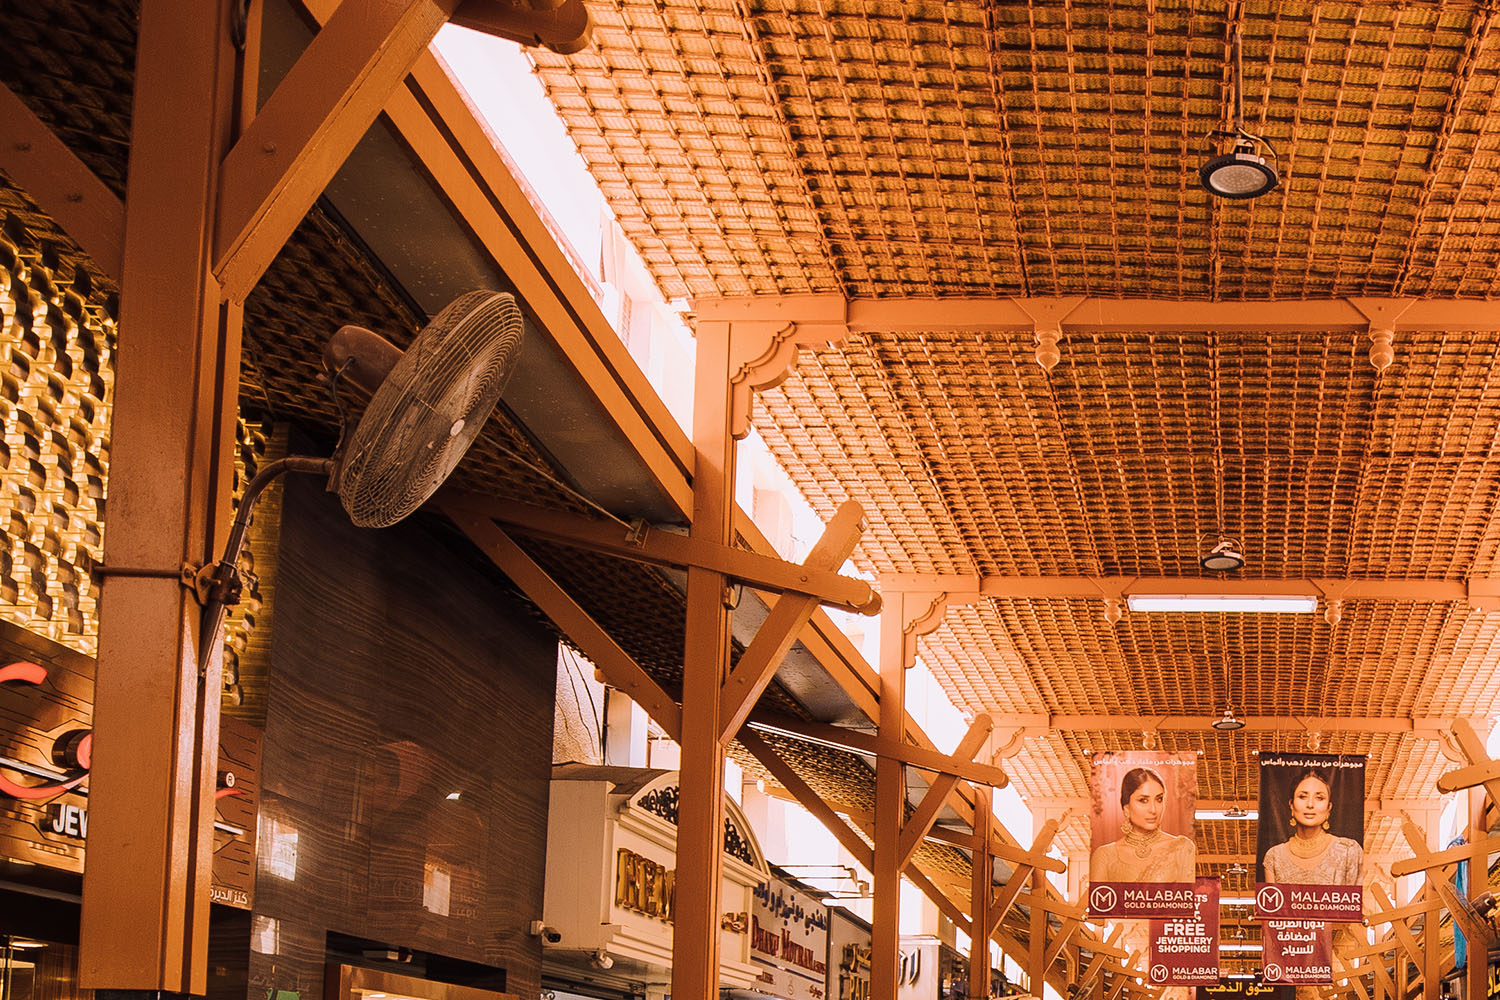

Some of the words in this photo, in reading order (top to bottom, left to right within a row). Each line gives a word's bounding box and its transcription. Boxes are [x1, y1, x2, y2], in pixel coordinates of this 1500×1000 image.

[1123, 890, 1194, 901] MALABAR
[1291, 891, 1361, 904] MALABAR
[1163, 923, 1205, 936] FREE
[1156, 937, 1213, 945] JEWELLERY
[1277, 931, 1316, 942] المضافة
[1158, 945, 1211, 954] SHOPPING!
[1281, 944, 1314, 956] للسياح
[1172, 967, 1218, 975] MALABAR
[1285, 966, 1331, 974] MALABAR
[1205, 981, 1243, 995] الذهب
[1245, 982, 1274, 996] سوق
